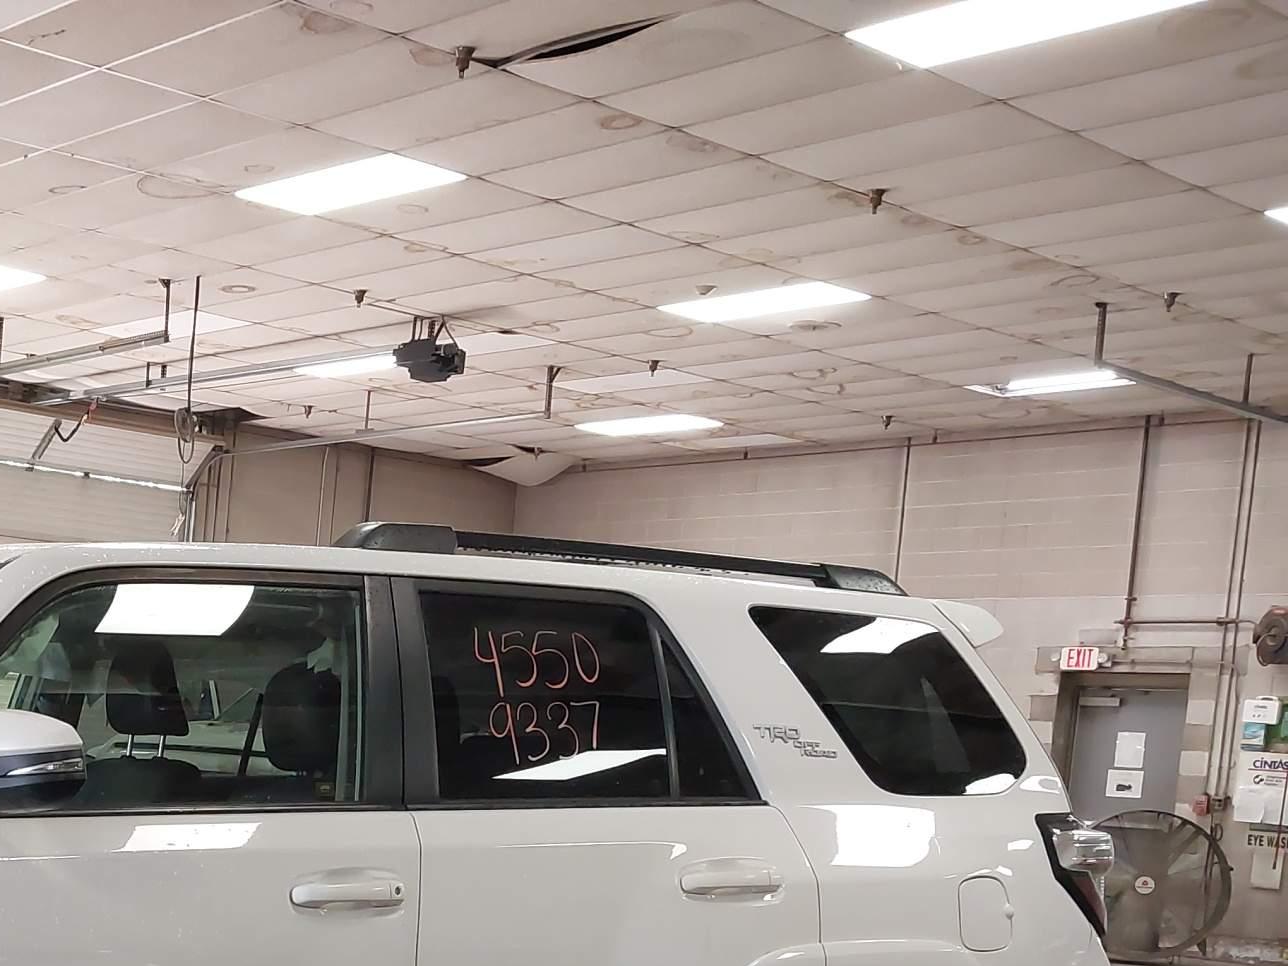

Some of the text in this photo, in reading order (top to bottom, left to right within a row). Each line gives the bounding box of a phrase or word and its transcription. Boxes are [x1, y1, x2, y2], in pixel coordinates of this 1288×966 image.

[474, 626, 600, 698] 4550
[1067, 648, 1094, 668] EXIT
[489, 701, 600, 765] 9337
[752, 724, 801, 743] TRD
[1248, 834, 1288, 848] EYE WS
